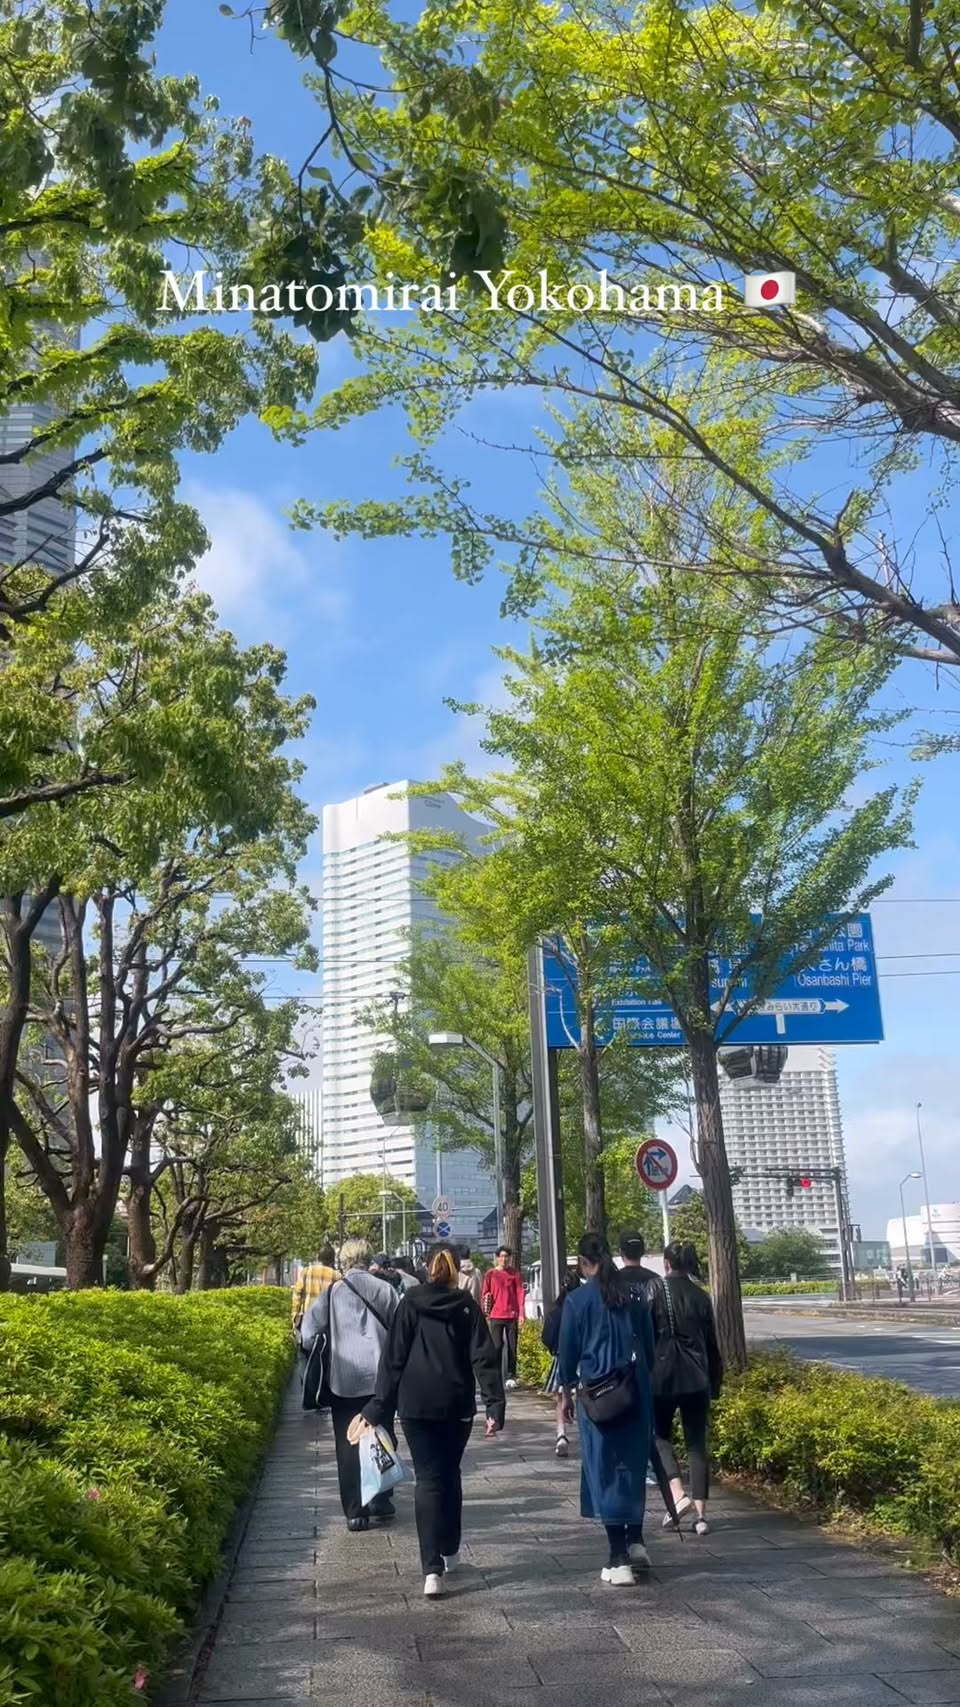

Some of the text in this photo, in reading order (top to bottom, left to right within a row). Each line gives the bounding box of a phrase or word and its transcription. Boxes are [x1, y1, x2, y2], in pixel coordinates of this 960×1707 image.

[847, 939, 870, 952] Park
[852, 973, 871, 986] Pier
[657, 1031, 681, 1039] Center
[437, 1202, 449, 1212] 40
